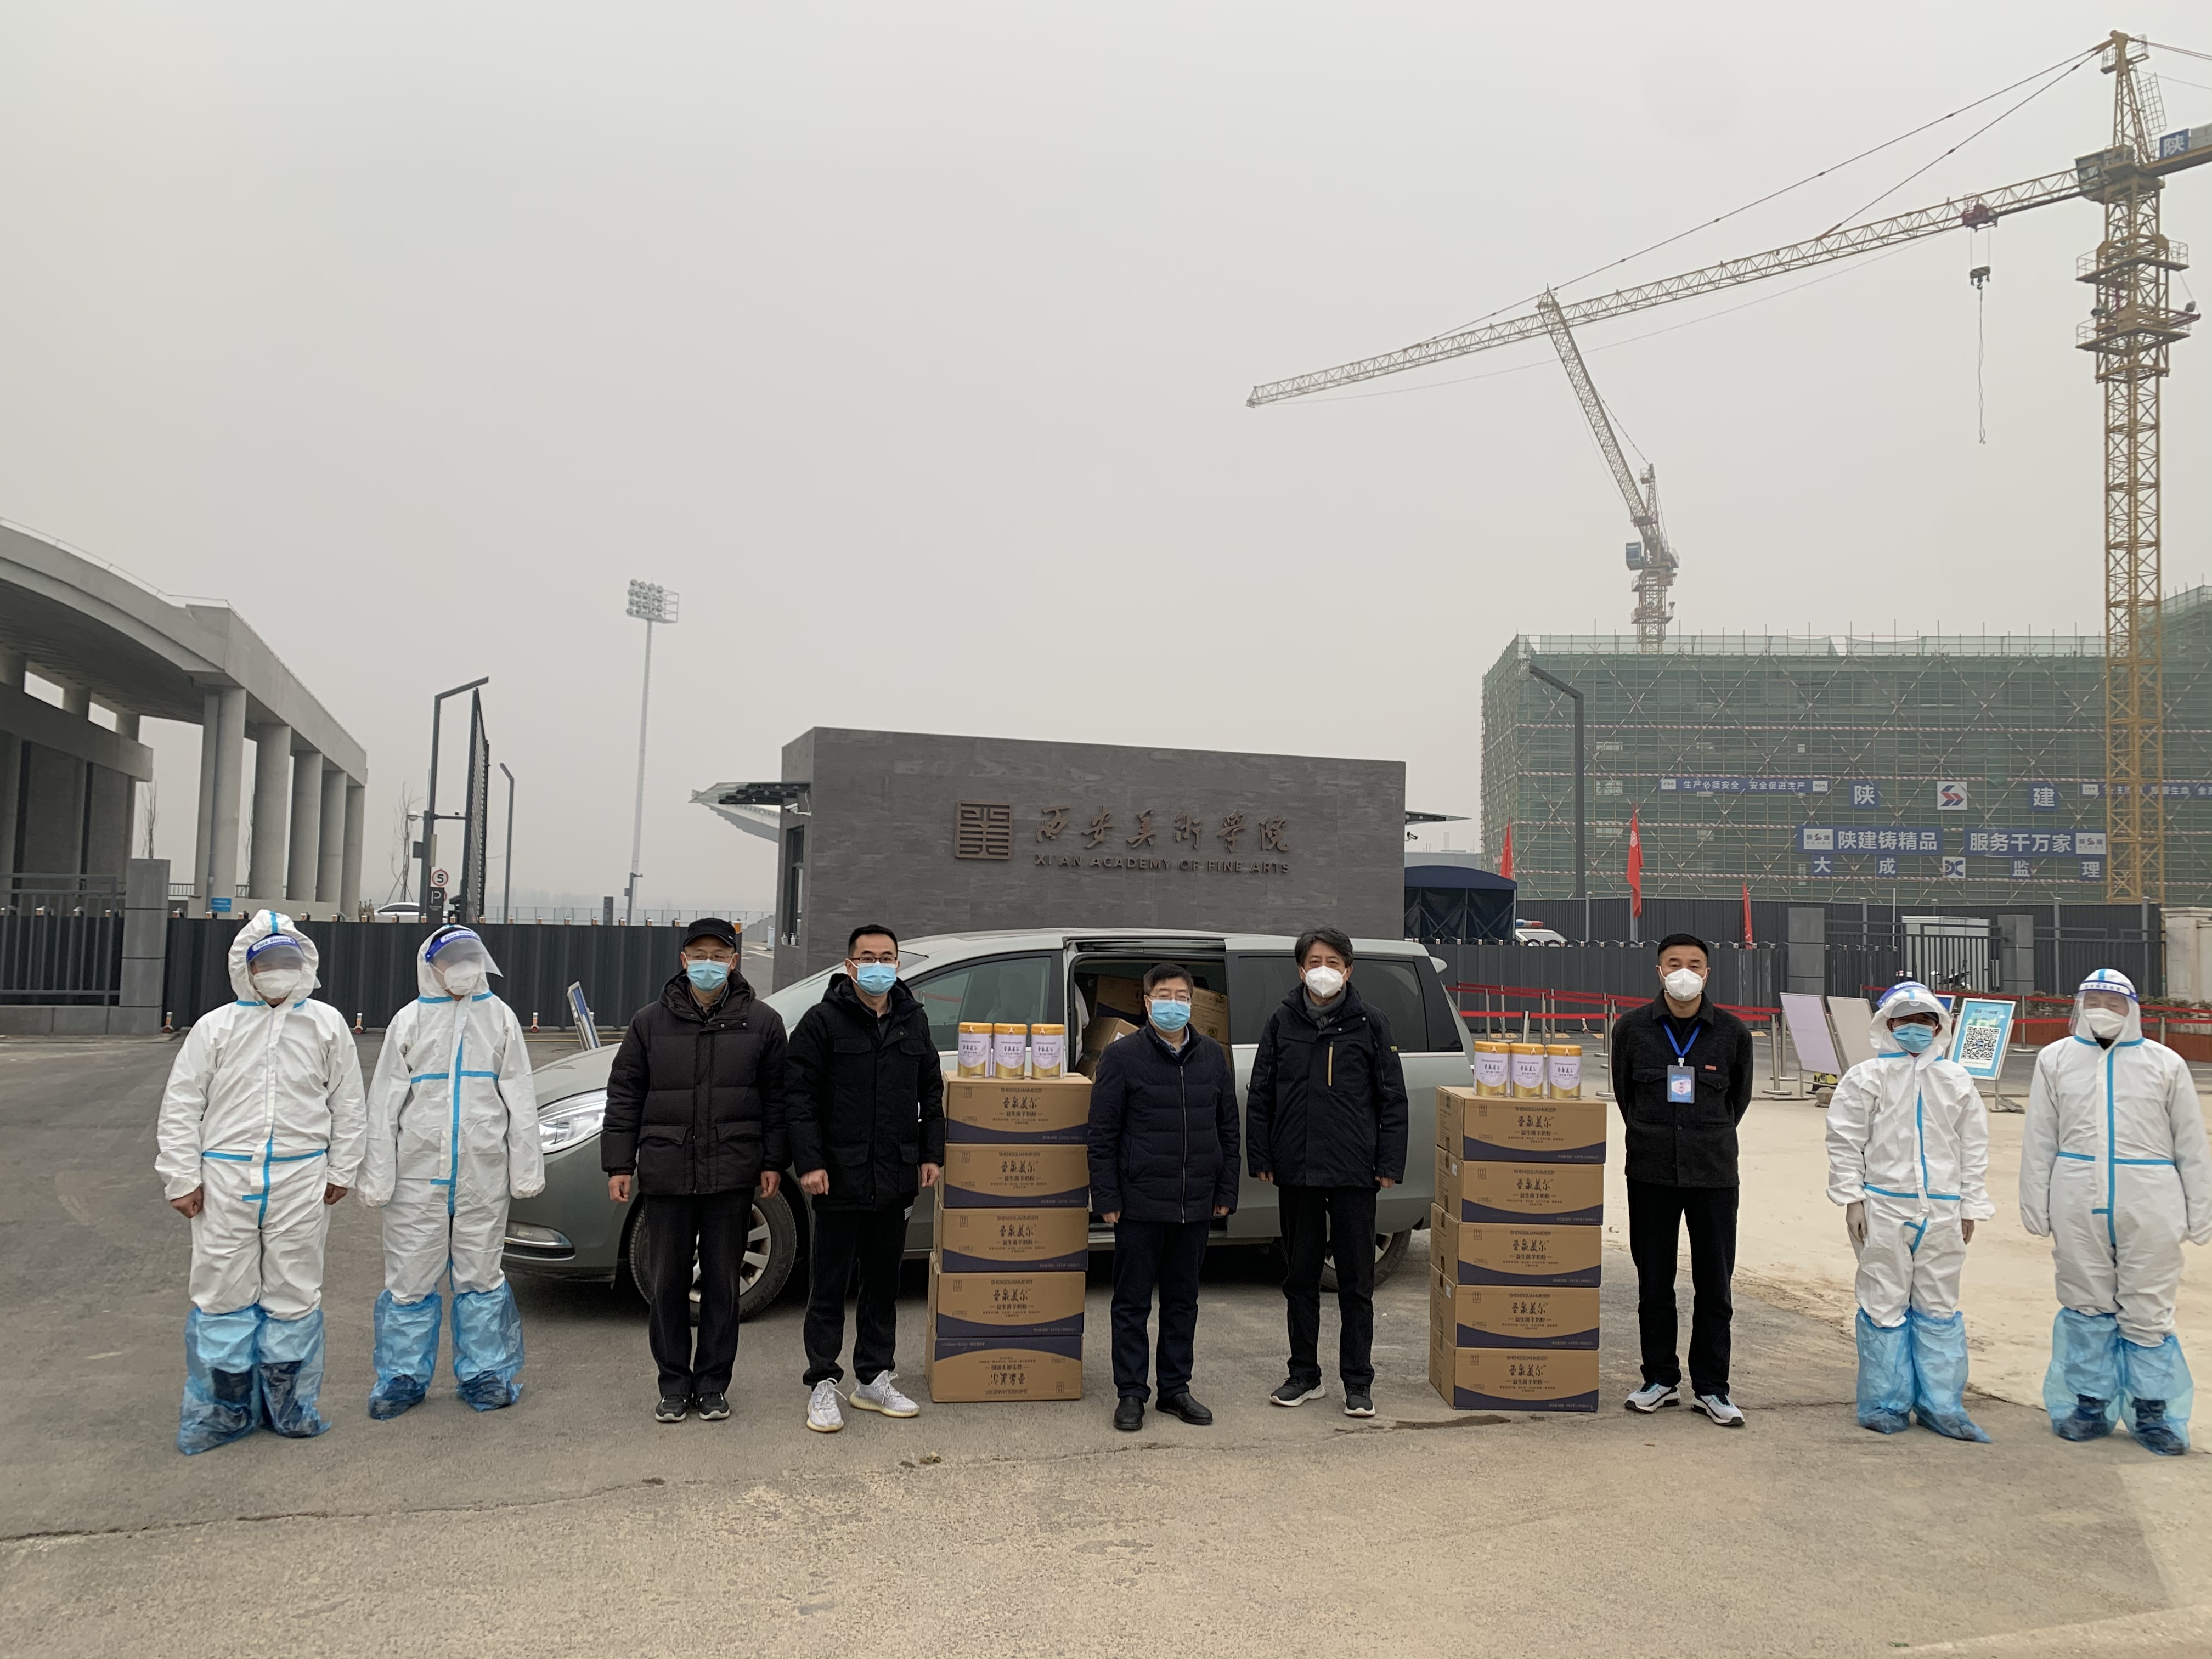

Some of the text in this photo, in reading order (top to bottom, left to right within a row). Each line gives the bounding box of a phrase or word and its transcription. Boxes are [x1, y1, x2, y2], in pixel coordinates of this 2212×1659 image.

[2164, 134, 2185, 157] 陕
[1684, 780, 1739, 789] 生产必须安全
[1749, 781, 1805, 790] 安全促进生产
[1854, 785, 2055, 807] 陕 建
[1838, 831, 1938, 850] 陕建铸精品
[1970, 832, 2072, 853] 服务千万家
[1089, 855, 1170, 870] ACADEMY
[1178, 860, 1200, 870] OF
[1207, 860, 1242, 872] FINE
[1249, 862, 1289, 873] ARTS
[1814, 856, 2101, 878] 大 成 监 理
[437, 874, 444, 883] 5
[431, 891, 441, 904] P
